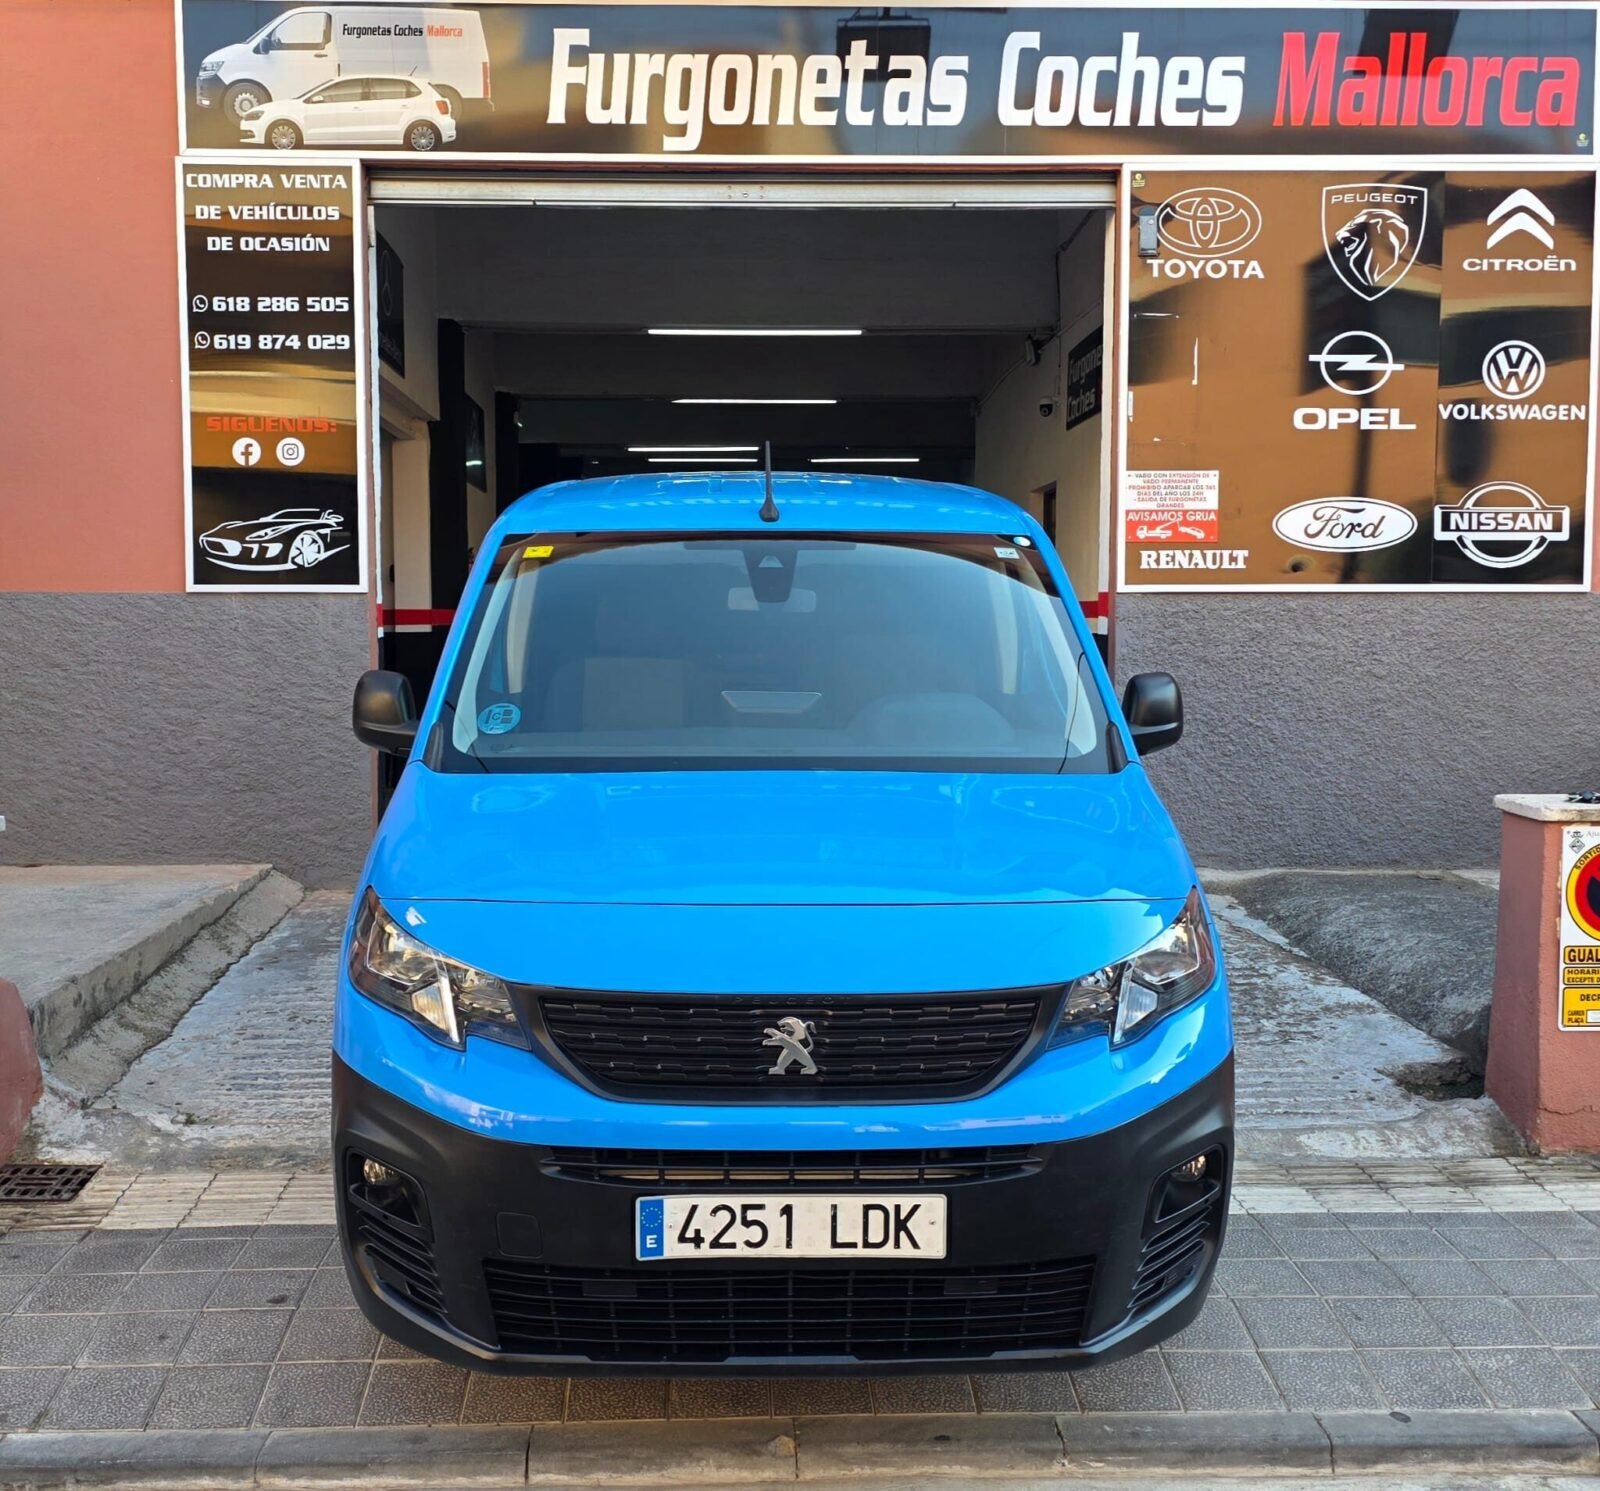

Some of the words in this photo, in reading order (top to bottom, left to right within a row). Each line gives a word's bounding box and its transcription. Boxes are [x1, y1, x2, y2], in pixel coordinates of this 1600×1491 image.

[342, 24, 391, 38] Furgonetas
[394, 24, 423, 36] Coches
[427, 25, 463, 37] Mallorca
[546, 28, 969, 151] Furgonetas
[997, 31, 1246, 127] Coches
[1273, 31, 1581, 127] Mallorca
[186, 173, 274, 188] COMPRA
[280, 174, 348, 189] VENTA
[1331, 192, 1418, 204] PEUGEOT
[195, 205, 221, 220] DE
[227, 202, 340, 221] VEHÍCULOS
[206, 236, 233, 251] DE
[240, 234, 330, 252] OCASIÓN
[1146, 259, 1265, 279] TOYOTA
[212, 296, 250, 312] 618
[257, 296, 300, 312] 286
[306, 296, 350, 312] 505
[213, 334, 251, 350] 619
[258, 334, 301, 350] 874
[307, 334, 350, 350] 029
[1293, 407, 1417, 430] OPEL
[1438, 403, 1586, 421] VOLKSWAGEN
[1127, 511, 1183, 521] AVISAMOS
[1186, 511, 1216, 521] GRUA
[1304, 505, 1386, 539] Ford
[1449, 512, 1553, 530] NISSAN
[1139, 549, 1249, 569] RENAULT
[1568, 948, 1600, 962] GUAL
[646, 1234, 657, 1248] E
[677, 1203, 794, 1250] 4251
[830, 1203, 922, 1250] LDK
